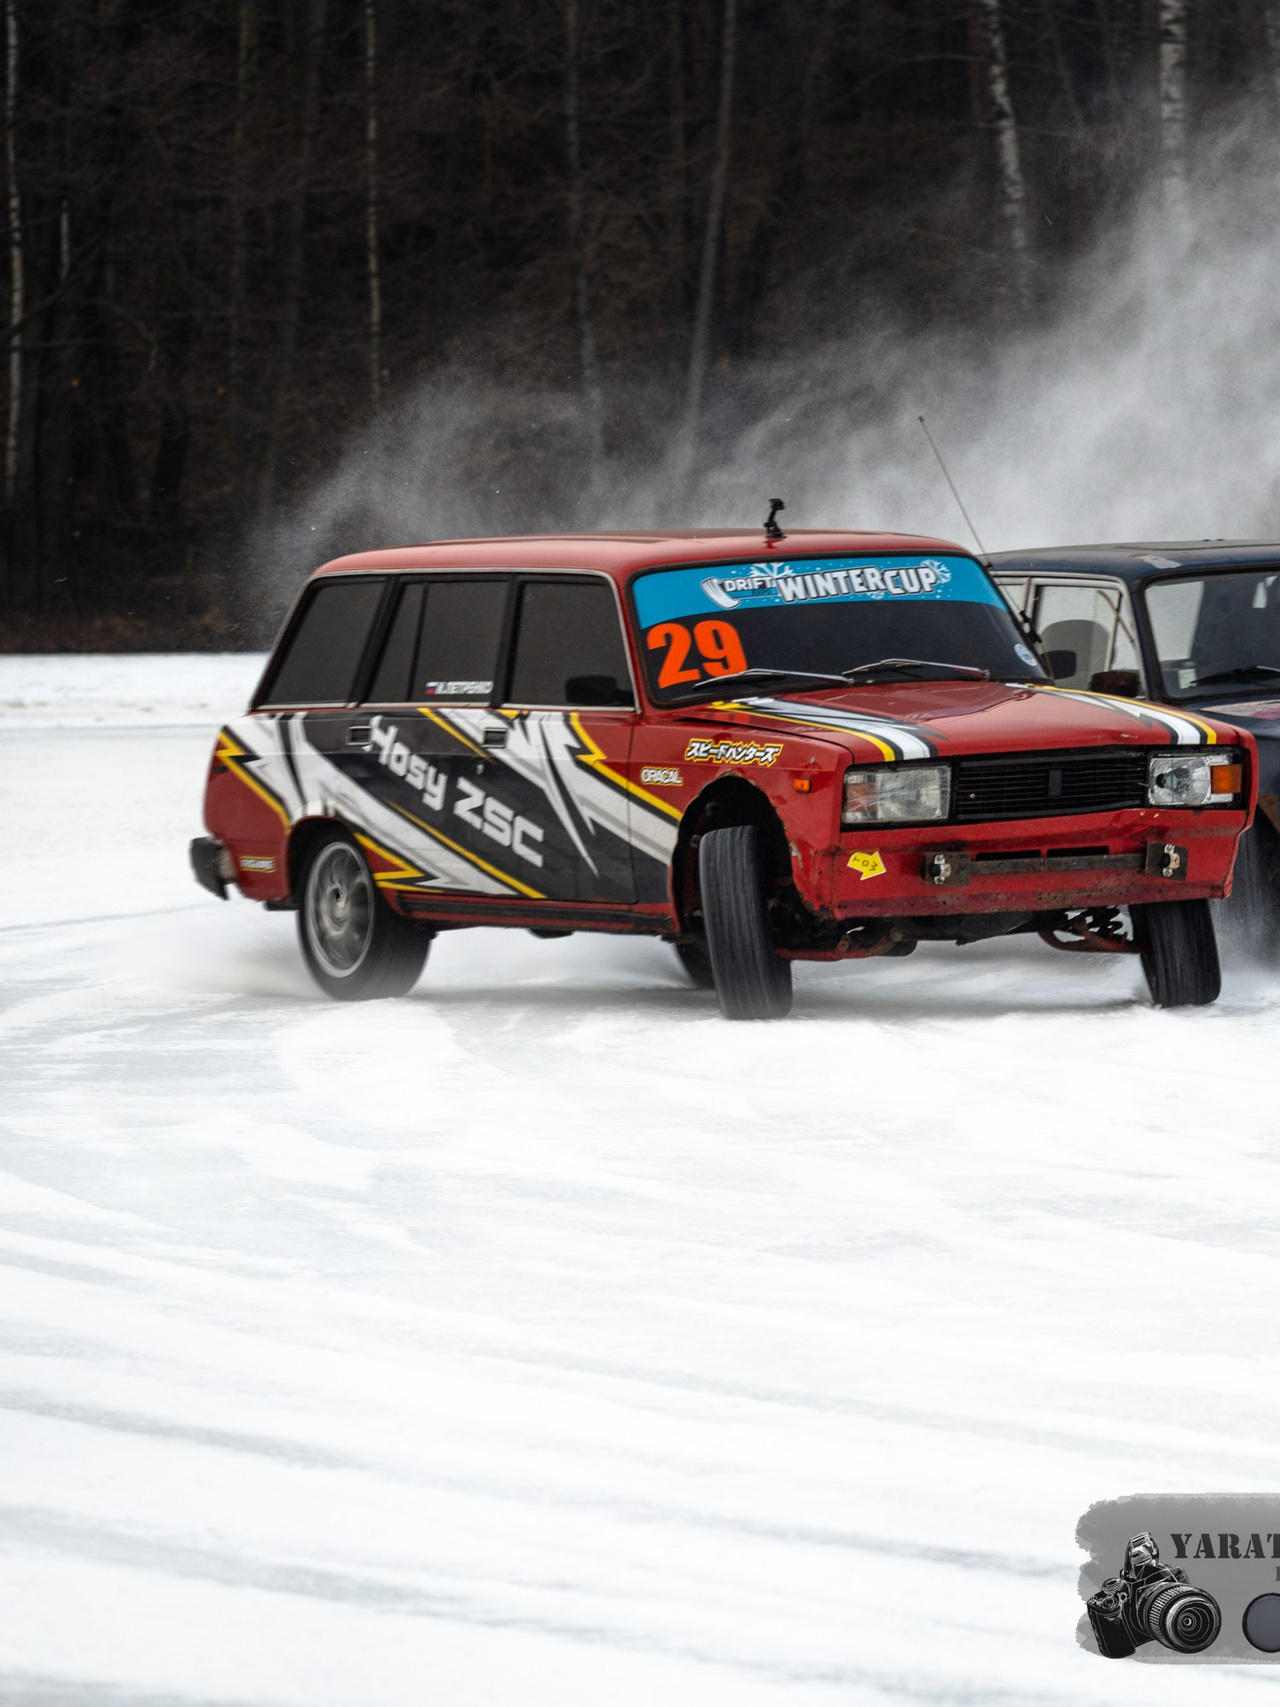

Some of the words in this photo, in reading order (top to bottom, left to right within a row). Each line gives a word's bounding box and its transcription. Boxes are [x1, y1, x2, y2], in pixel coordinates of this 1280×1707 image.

[722, 576, 774, 592] DRIFT
[646, 620, 747, 689] 29
[640, 767, 682, 785] ORACAL
[453, 776, 545, 868] ZSC
